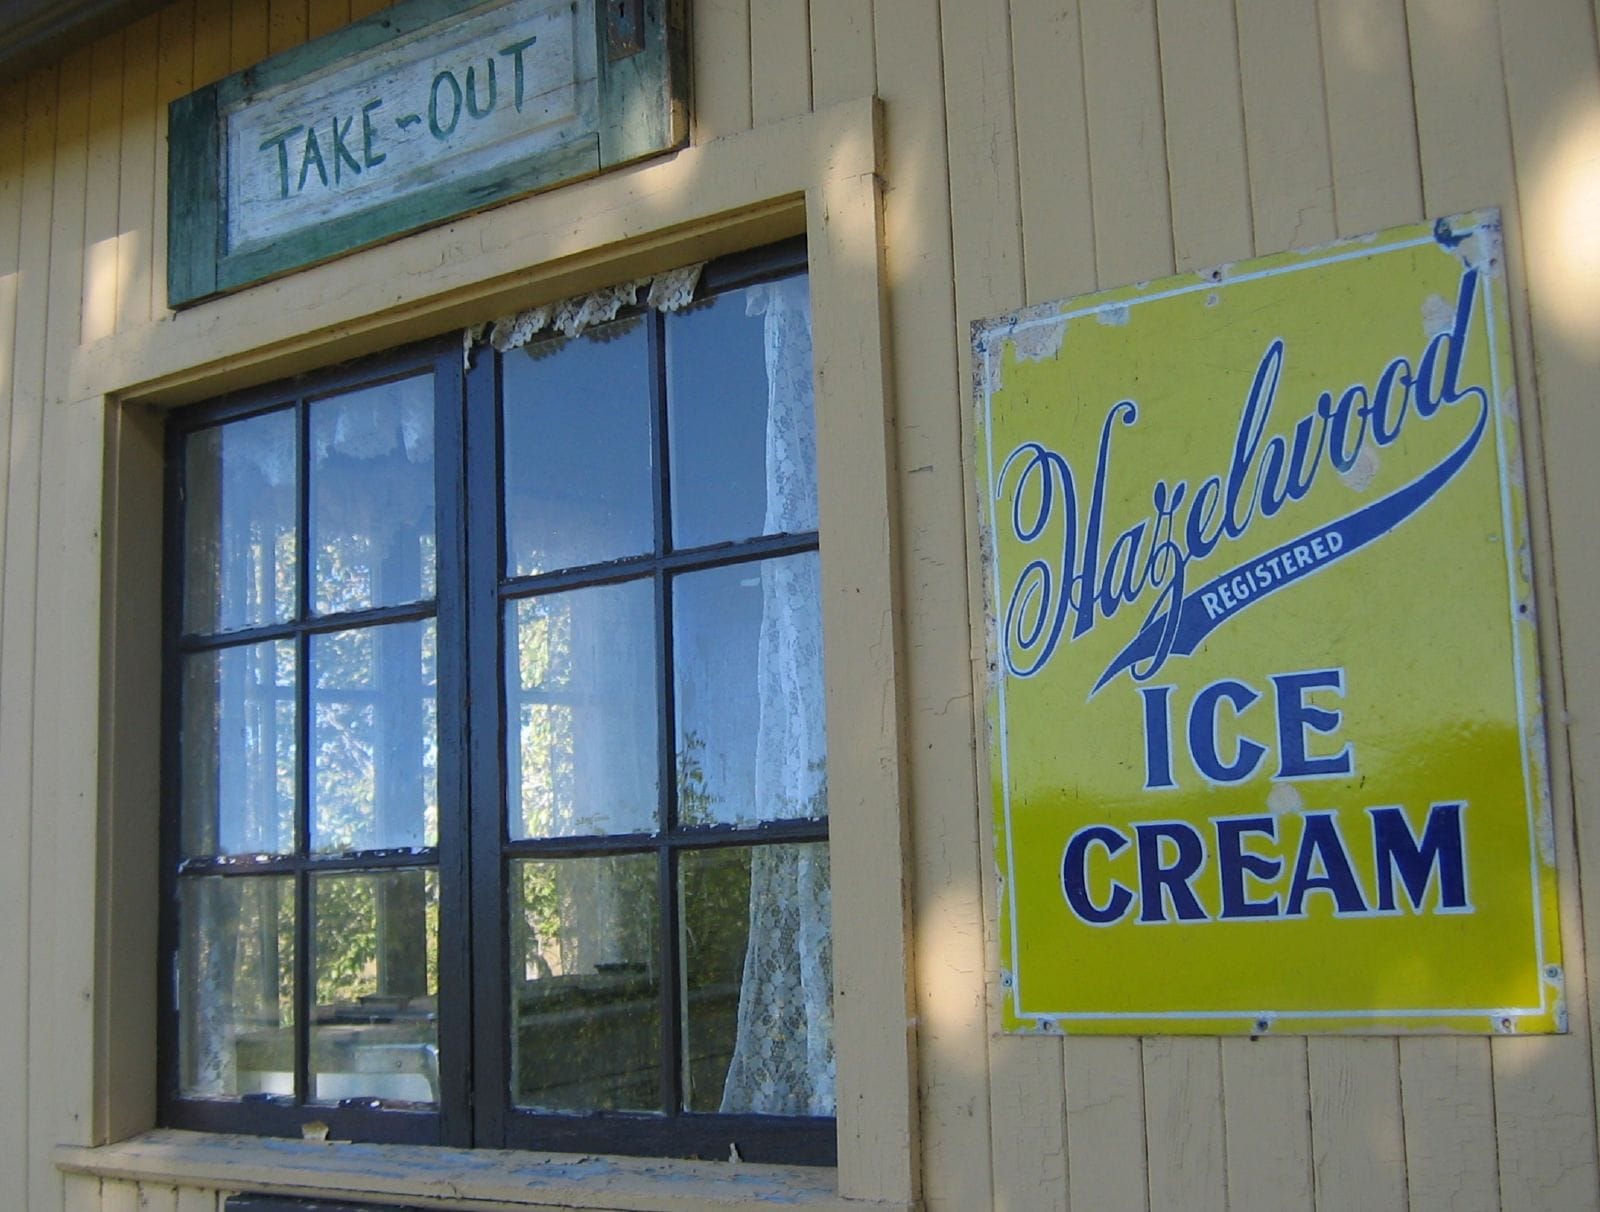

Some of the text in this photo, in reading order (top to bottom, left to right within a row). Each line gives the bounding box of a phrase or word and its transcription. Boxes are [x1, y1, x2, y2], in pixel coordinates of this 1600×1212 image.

[258, 36, 537, 200] TAKE-OUT
[998, 268, 1486, 682] Hazelwood
[1201, 531, 1344, 620] REGISTERED
[1137, 667, 1354, 791] ICE
[1061, 801, 1475, 927] CREAM
